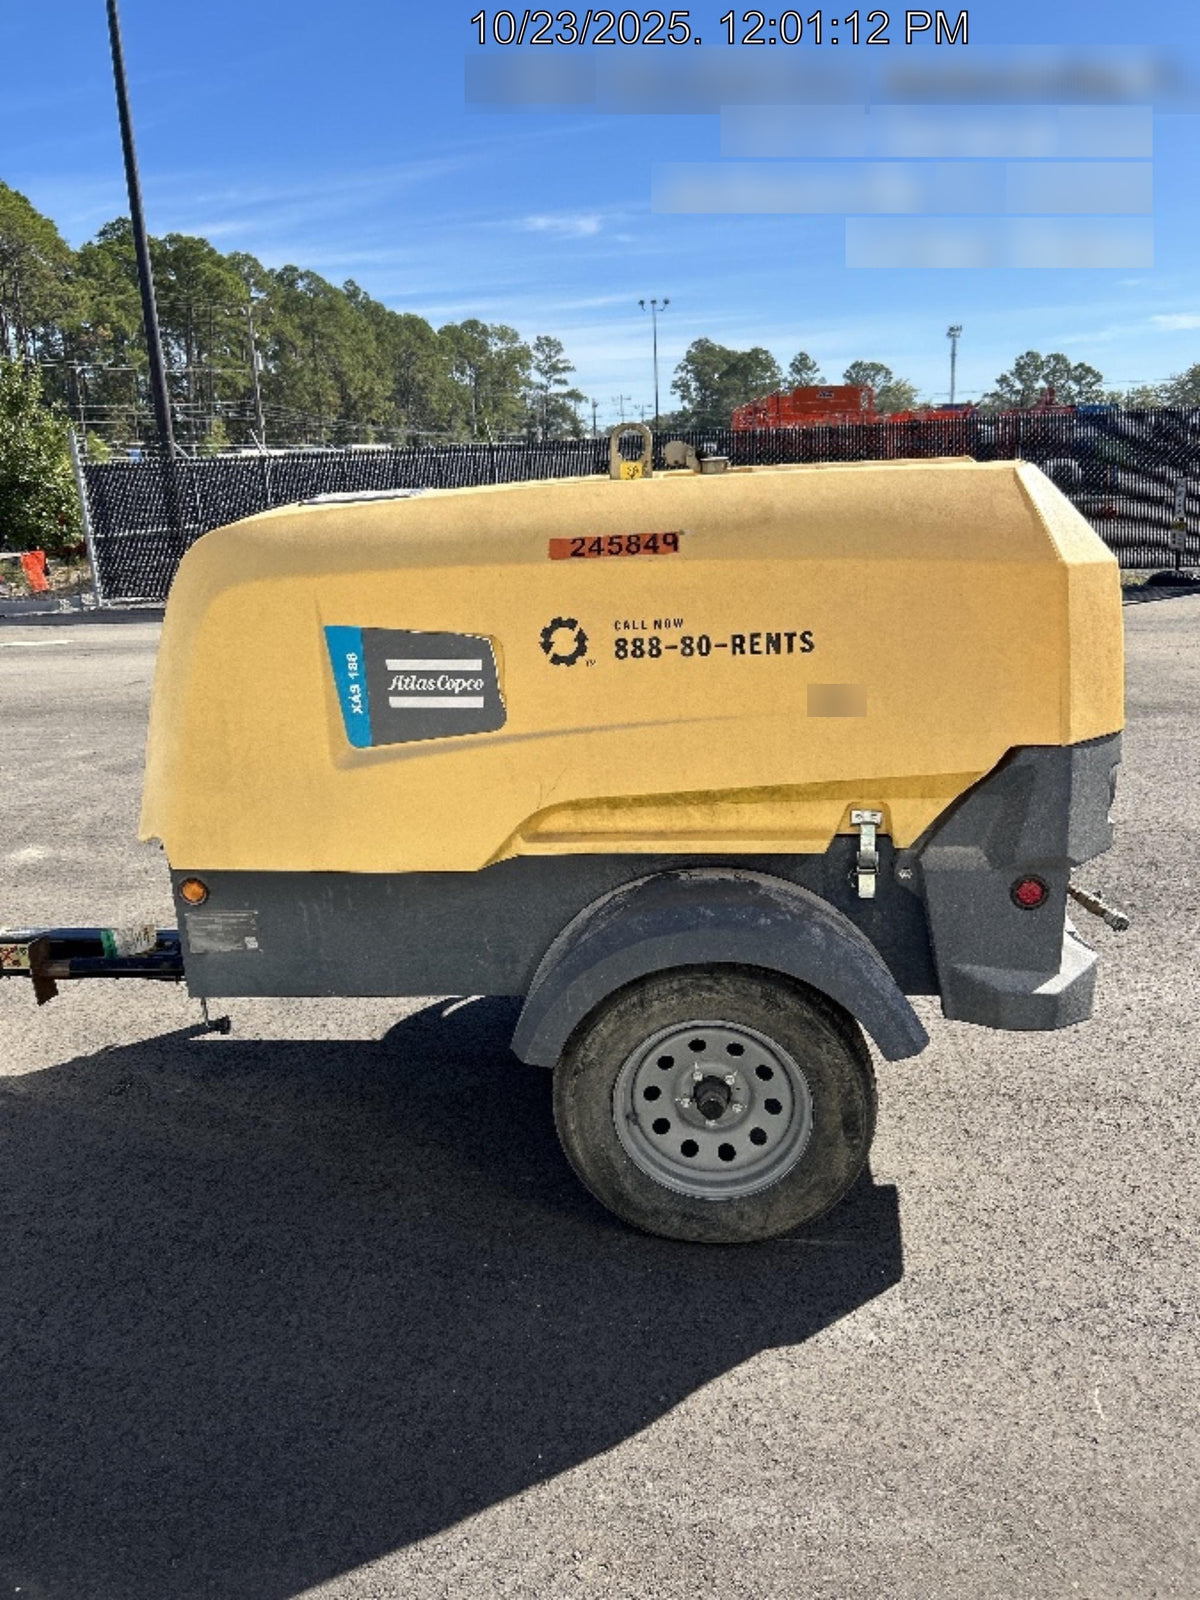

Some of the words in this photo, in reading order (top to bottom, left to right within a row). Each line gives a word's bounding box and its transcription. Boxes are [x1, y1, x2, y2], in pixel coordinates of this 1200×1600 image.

[569, 531, 680, 558] 245849
[614, 620, 648, 631] CALL
[654, 618, 684, 630] NOW
[614, 630, 815, 660] 888-80-RENTS
